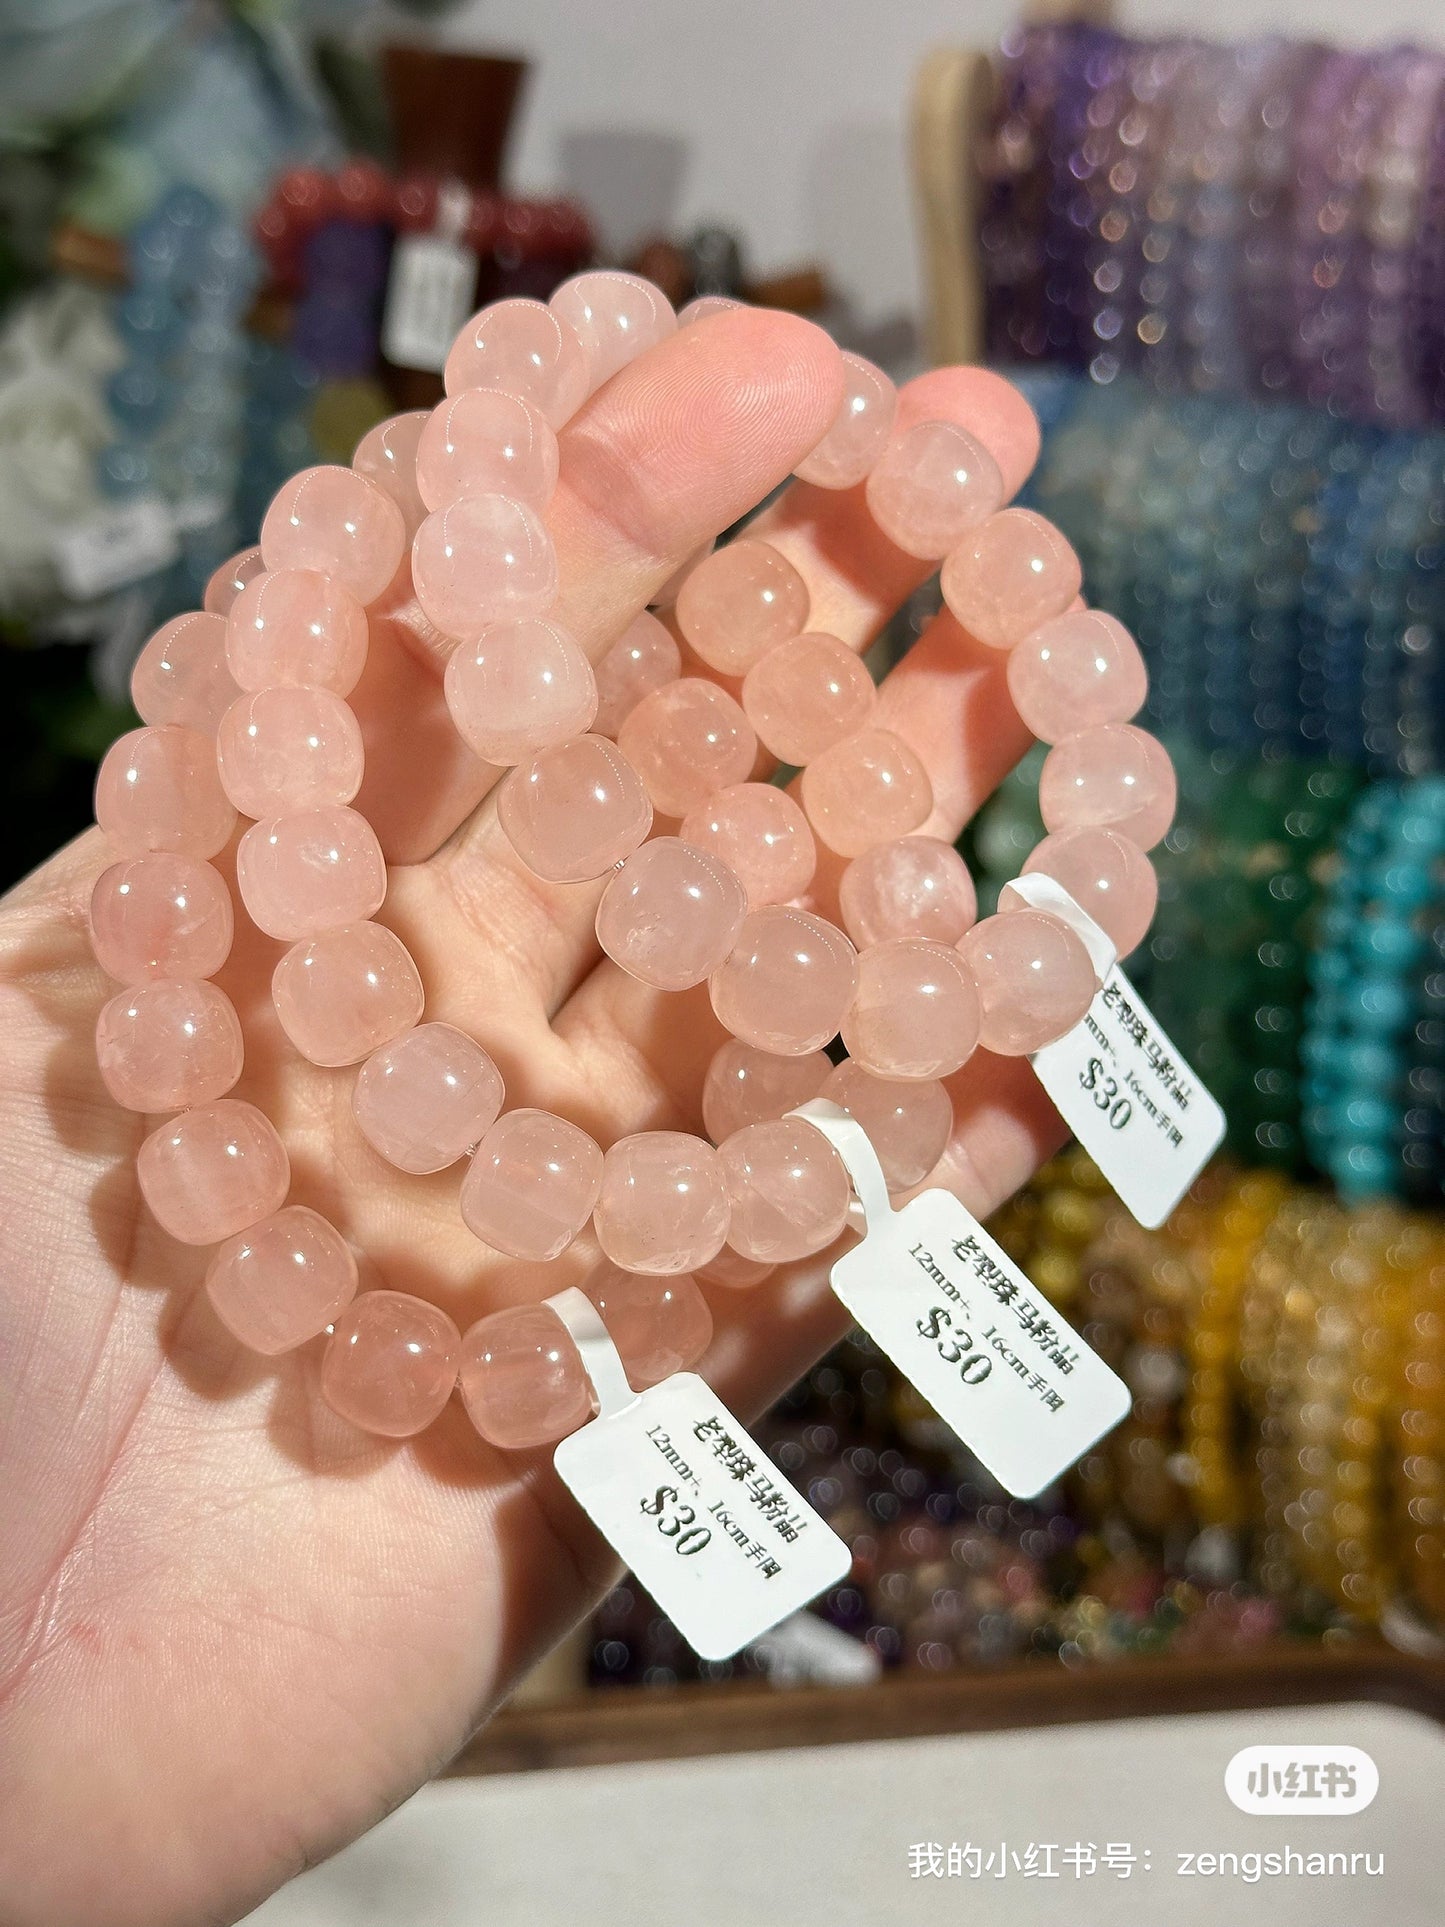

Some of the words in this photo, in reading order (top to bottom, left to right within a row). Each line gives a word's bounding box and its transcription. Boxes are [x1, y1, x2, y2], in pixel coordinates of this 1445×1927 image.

[1079, 1057, 1132, 1130] $30
[915, 1306, 993, 1386] $30
[640, 1485, 712, 1556] $30
